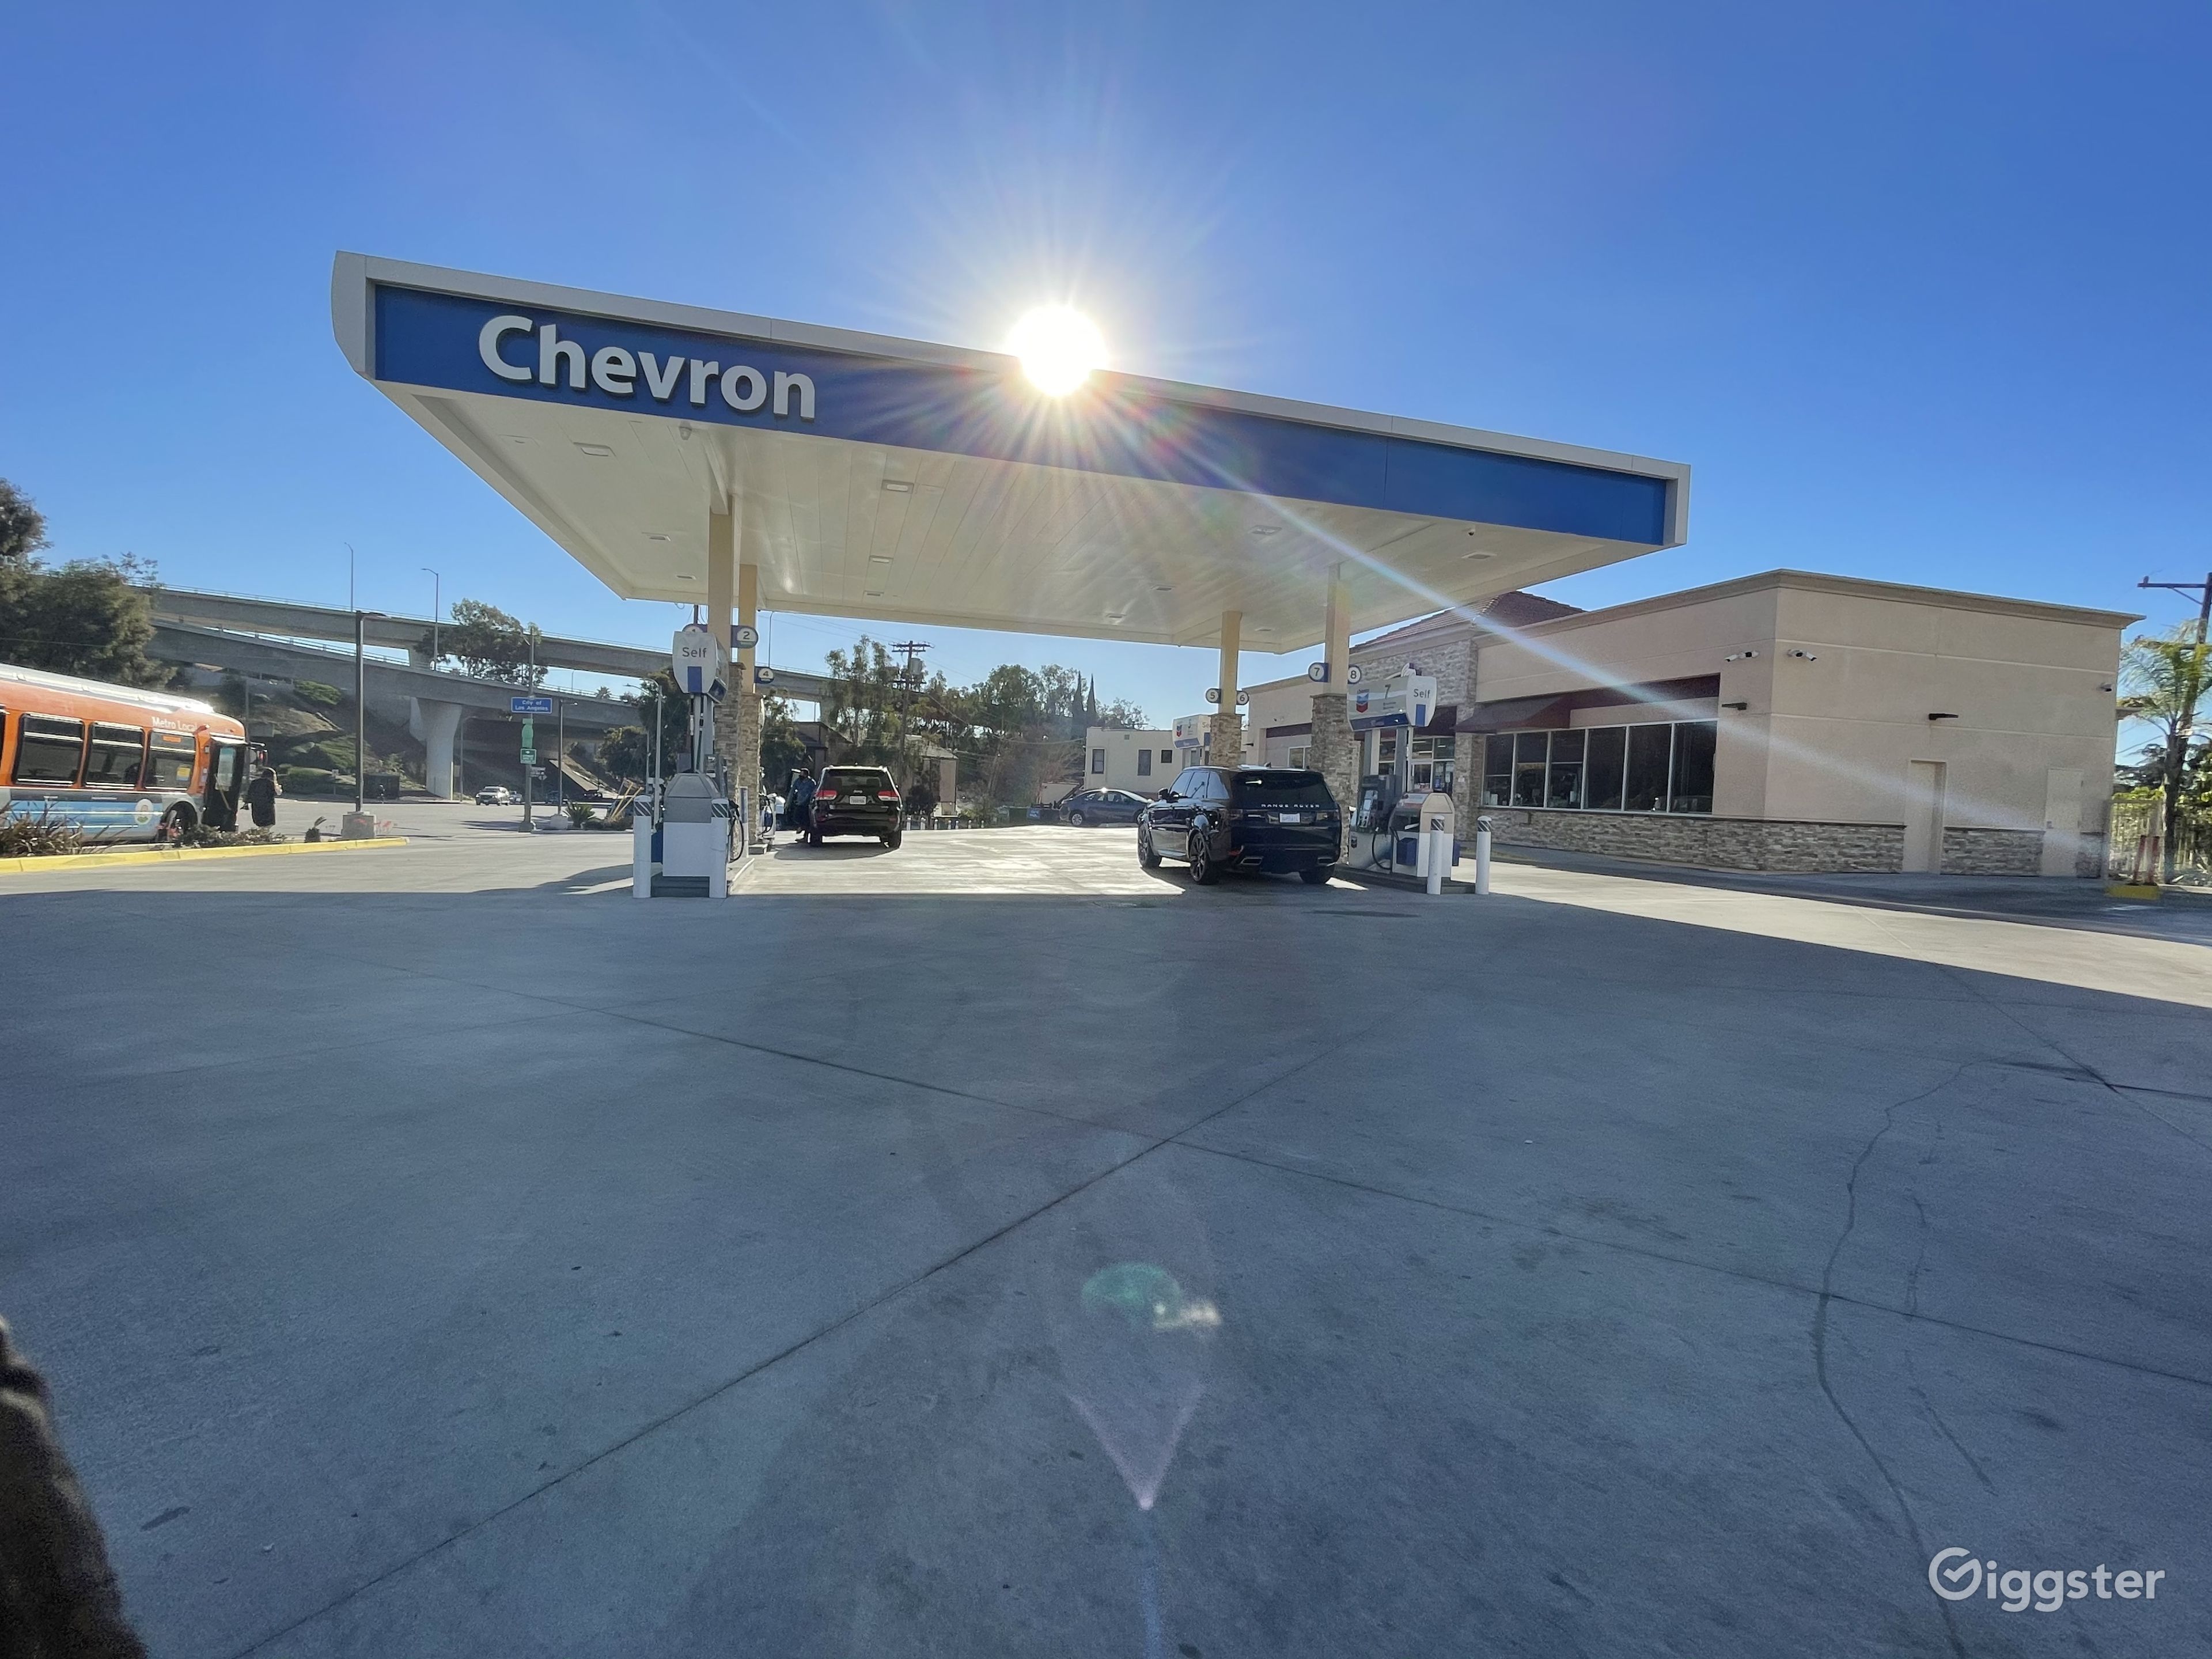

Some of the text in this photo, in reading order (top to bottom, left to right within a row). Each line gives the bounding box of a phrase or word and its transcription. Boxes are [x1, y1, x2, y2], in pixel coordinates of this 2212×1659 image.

[479, 315, 816, 420] Chevron
[743, 631, 750, 640] 2
[682, 647, 707, 658] Self
[1314, 667, 1320, 676] 7
[1350, 670, 1357, 679] 8
[1385, 684, 1391, 699] 7
[1413, 688, 1430, 699] Self
[151, 716, 198, 732] Metro Local
